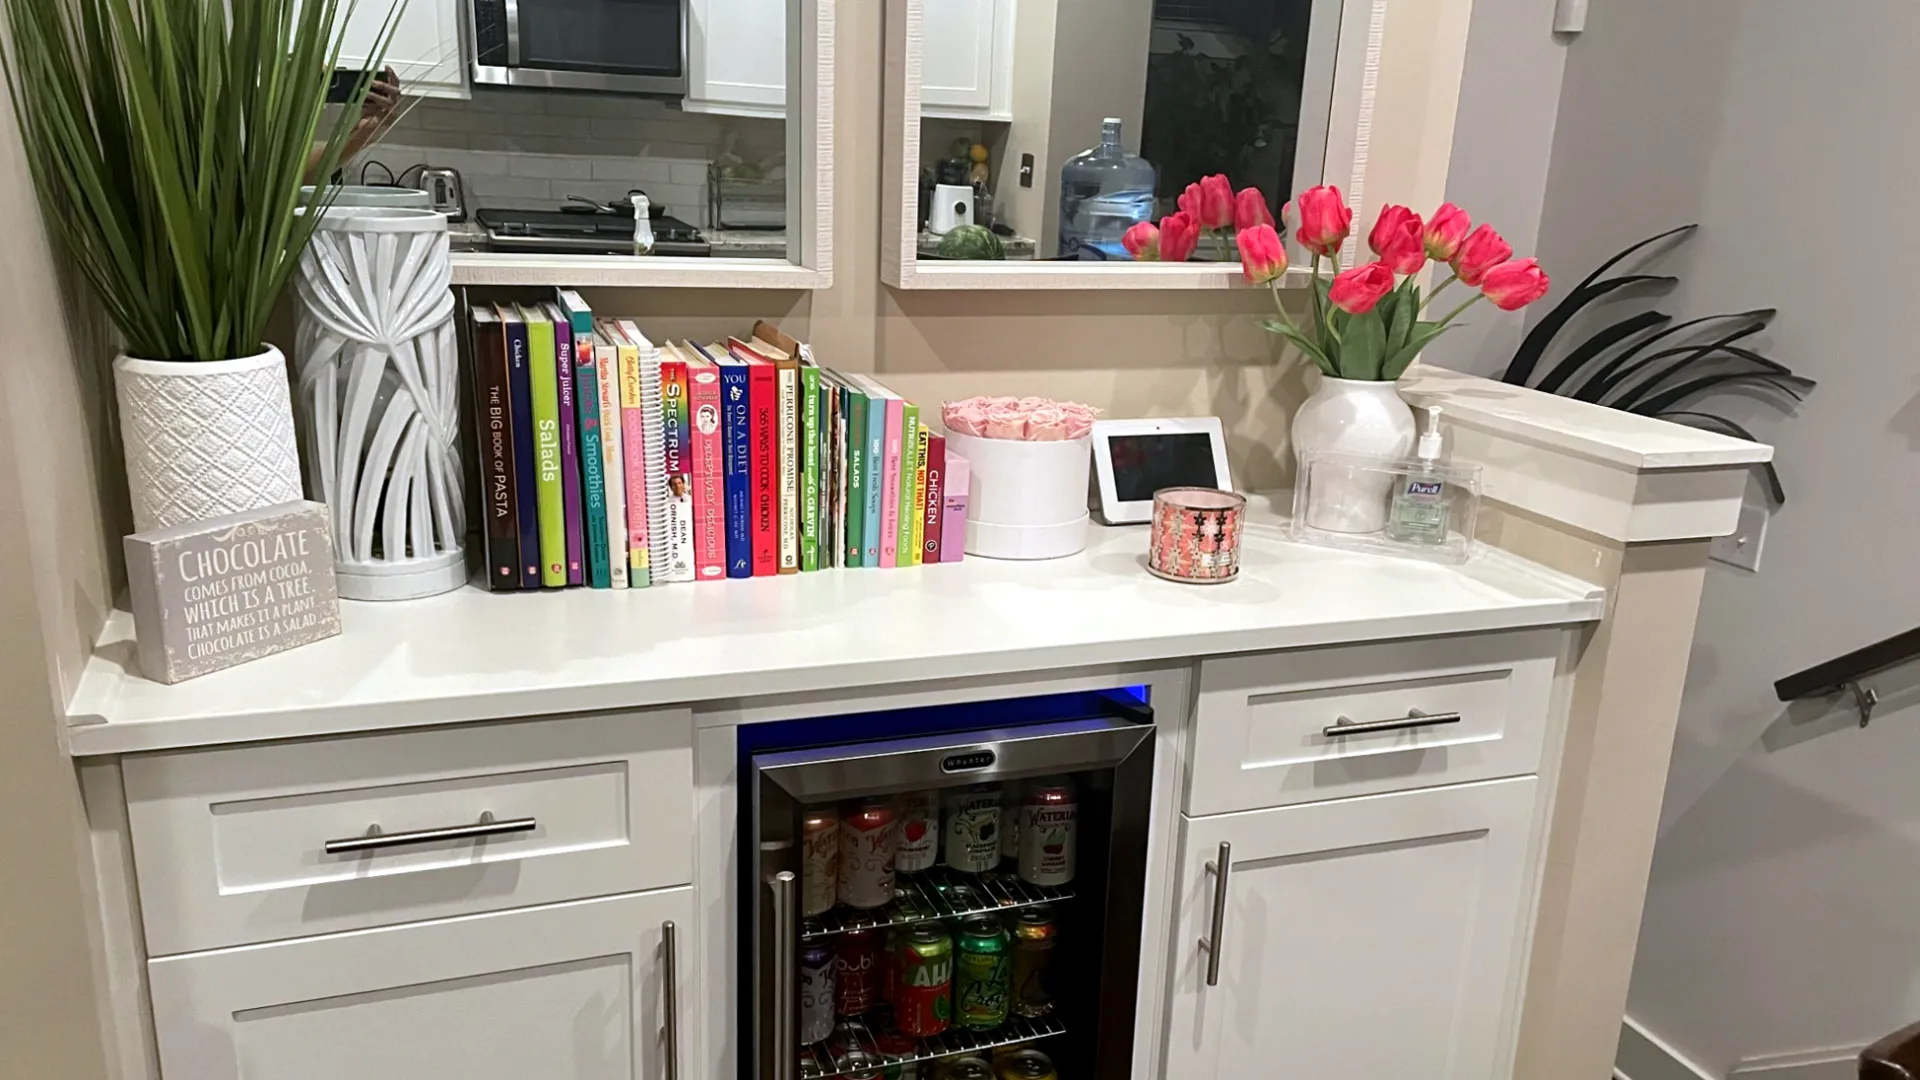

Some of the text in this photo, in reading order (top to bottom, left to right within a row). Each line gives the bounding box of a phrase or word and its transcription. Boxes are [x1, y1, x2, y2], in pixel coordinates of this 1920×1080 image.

[513, 338, 522, 368] Chicken
[559, 343, 569, 374] Super
[599, 357, 610, 380] Martha
[626, 356, 638, 405] Betty Crocker
[724, 374, 746, 383] YOU
[601, 382, 613, 408] Stewart's
[807, 395, 816, 416] turn
[584, 417, 598, 431] &
[666, 383, 680, 471] SPECTRUM
[786, 385, 794, 443] PERRICONE
[806, 417, 815, 428] up
[490, 386, 508, 518] THE BIG BOOK OF PASTA
[539, 419, 559, 482] Salads
[627, 408, 642, 470] cookbook
[736, 404, 747, 475] ON A DIET
[807, 428, 816, 444] the
[919, 431, 928, 446] EAT
[585, 434, 603, 508] Smoothies
[760, 408, 770, 532] 365 WAYS TO COOK CHICKEN
[786, 447, 795, 493] PROMISE
[807, 445, 816, 466] heat
[853, 450, 861, 488] SALADS
[872, 456, 880, 473] Best
[917, 446, 927, 469] THIS,
[806, 486, 816, 497] G.
[904, 472, 914, 500] Natural
[916, 469, 926, 486] NOT
[1411, 483, 1438, 494] Purell
[631, 477, 645, 530] women
[703, 439, 716, 559] DECEPTIVELY DELICIOUS
[916, 487, 926, 510] THAT!
[927, 470, 938, 524] CHICKEN
[670, 504, 678, 541] ORNISH,
[806, 497, 815, 537] GARVIN
[902, 501, 912, 531] Healing
[178, 530, 309, 582] CHOCOLATE
[901, 532, 911, 554] Foods
[183, 576, 316, 624] WHICH IS A TREE.
[184, 579, 228, 603] COMES
[231, 570, 267, 591] FROM
[186, 623, 214, 642] THAT
[216, 614, 256, 633] MAKES
[256, 608, 270, 622] IT
[272, 605, 280, 619] A
[187, 629, 256, 660] CHOCOLATE
[257, 625, 270, 640] IS
[272, 622, 281, 636] A
[947, 755, 991, 767] Whynter
